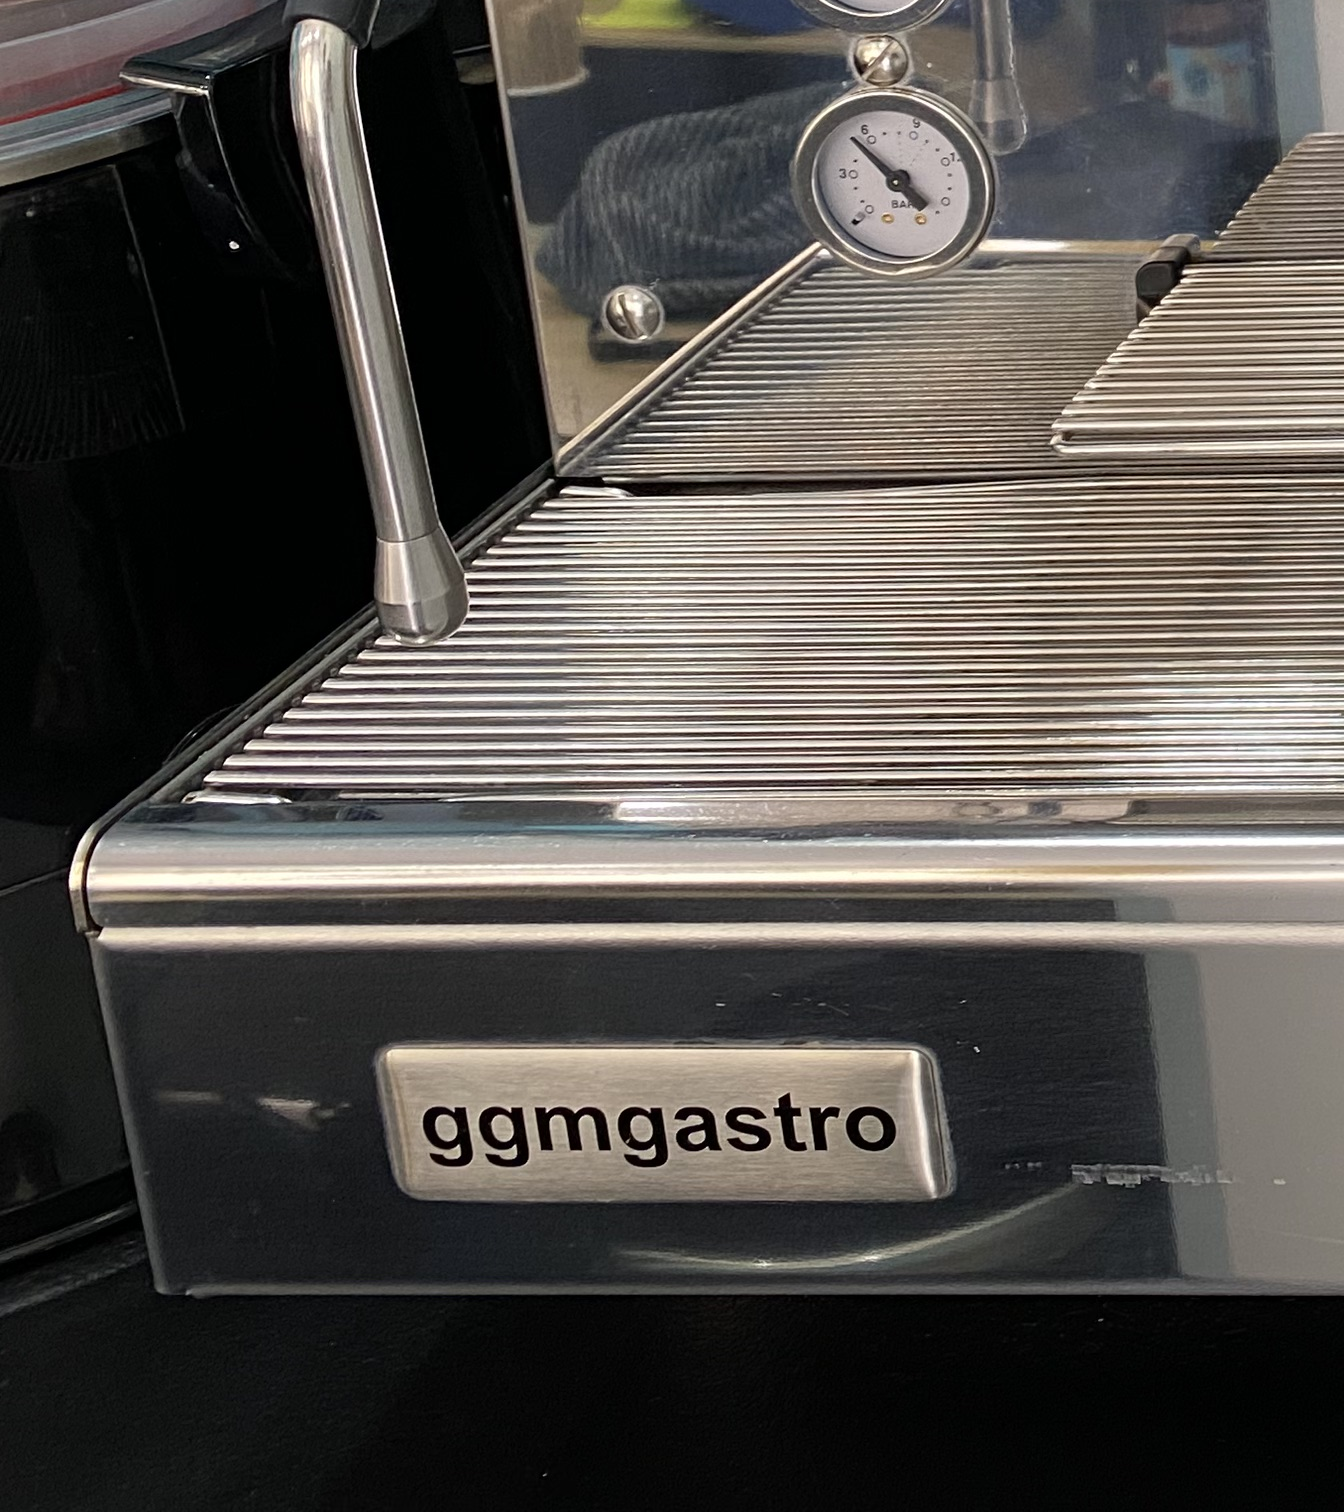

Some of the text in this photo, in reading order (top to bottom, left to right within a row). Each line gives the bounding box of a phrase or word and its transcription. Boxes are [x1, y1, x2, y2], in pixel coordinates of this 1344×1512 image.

[912, 118, 921, 129] 9
[860, 124, 869, 135] 6
[839, 168, 848, 179] 3
[422, 1091, 898, 1168] ggmgastro
